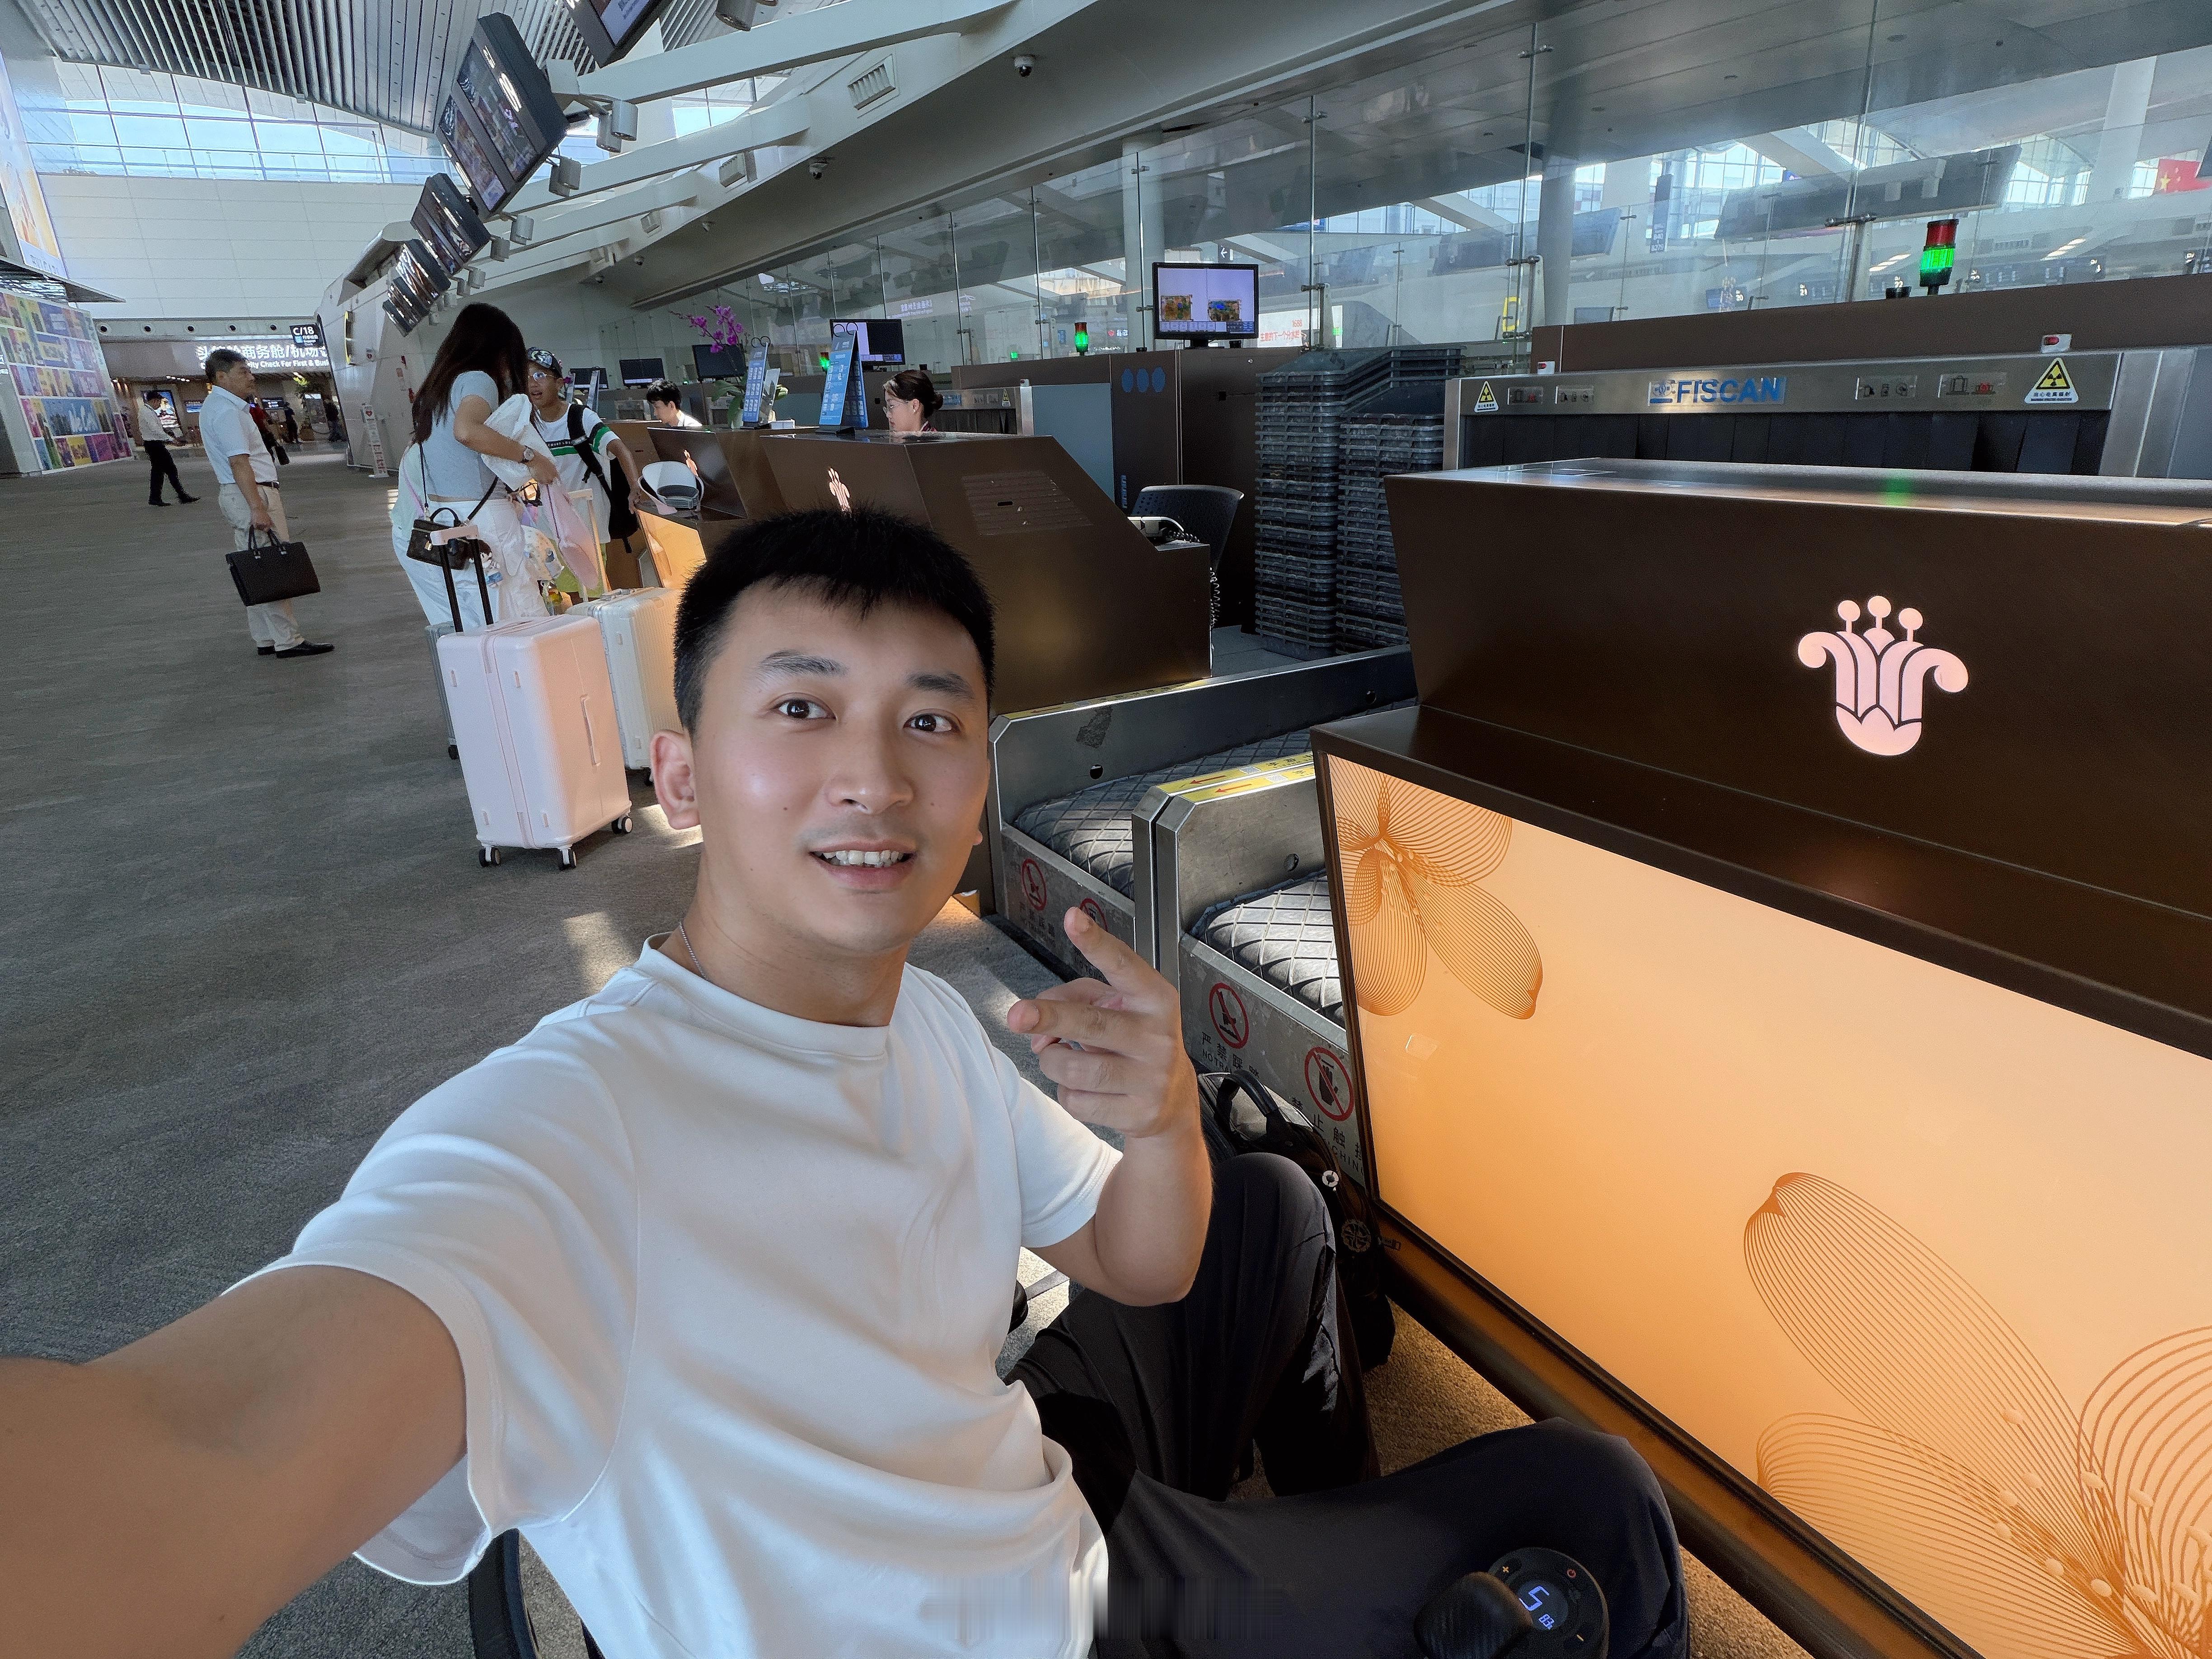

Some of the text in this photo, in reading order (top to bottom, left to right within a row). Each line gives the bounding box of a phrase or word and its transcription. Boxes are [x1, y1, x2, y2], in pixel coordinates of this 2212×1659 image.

[293, 326, 314, 336] C/18
[1677, 377, 1786, 403] FISCAN
[1202, 1049, 1213, 1062] NO
[1519, 1586, 1550, 1611] 5
